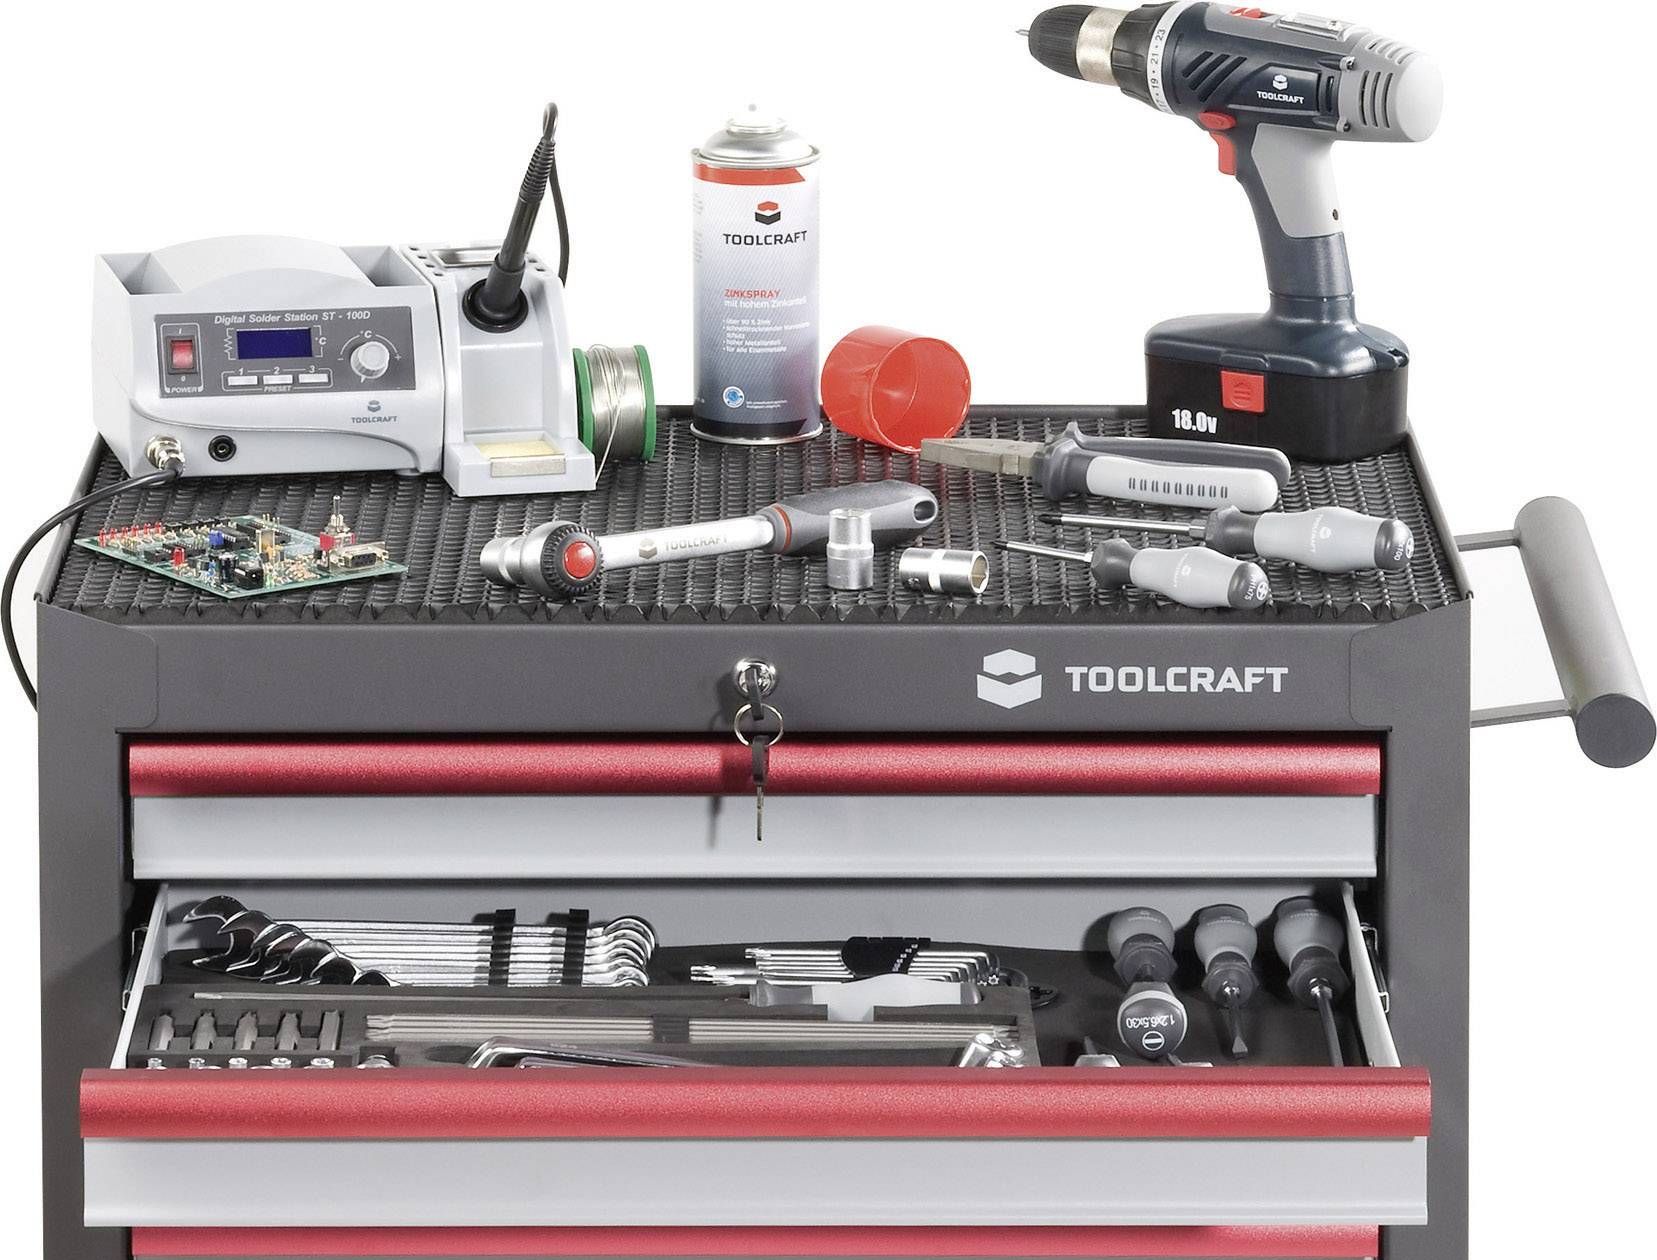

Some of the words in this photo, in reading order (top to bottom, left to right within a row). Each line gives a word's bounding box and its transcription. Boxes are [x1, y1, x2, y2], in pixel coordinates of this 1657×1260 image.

[1154, 28, 1167, 41] 23
[1150, 52, 1159, 65] 21
[1150, 77, 1160, 89] 19
[1256, 90, 1305, 104] TOOLCRAFT
[722, 230, 808, 246] TOOLCRAFT
[214, 314, 246, 326] Digital
[248, 313, 281, 323] Solder
[284, 311, 318, 322] Station
[322, 311, 336, 321] ST
[346, 310, 371, 320] 100D
[273, 366, 280, 375] 2
[309, 365, 316, 373] 3
[351, 415, 398, 424] TOOLCRAFT
[664, 534, 728, 552] TOOLCRAFT
[1065, 666, 1289, 693] TOOLCRAFT
